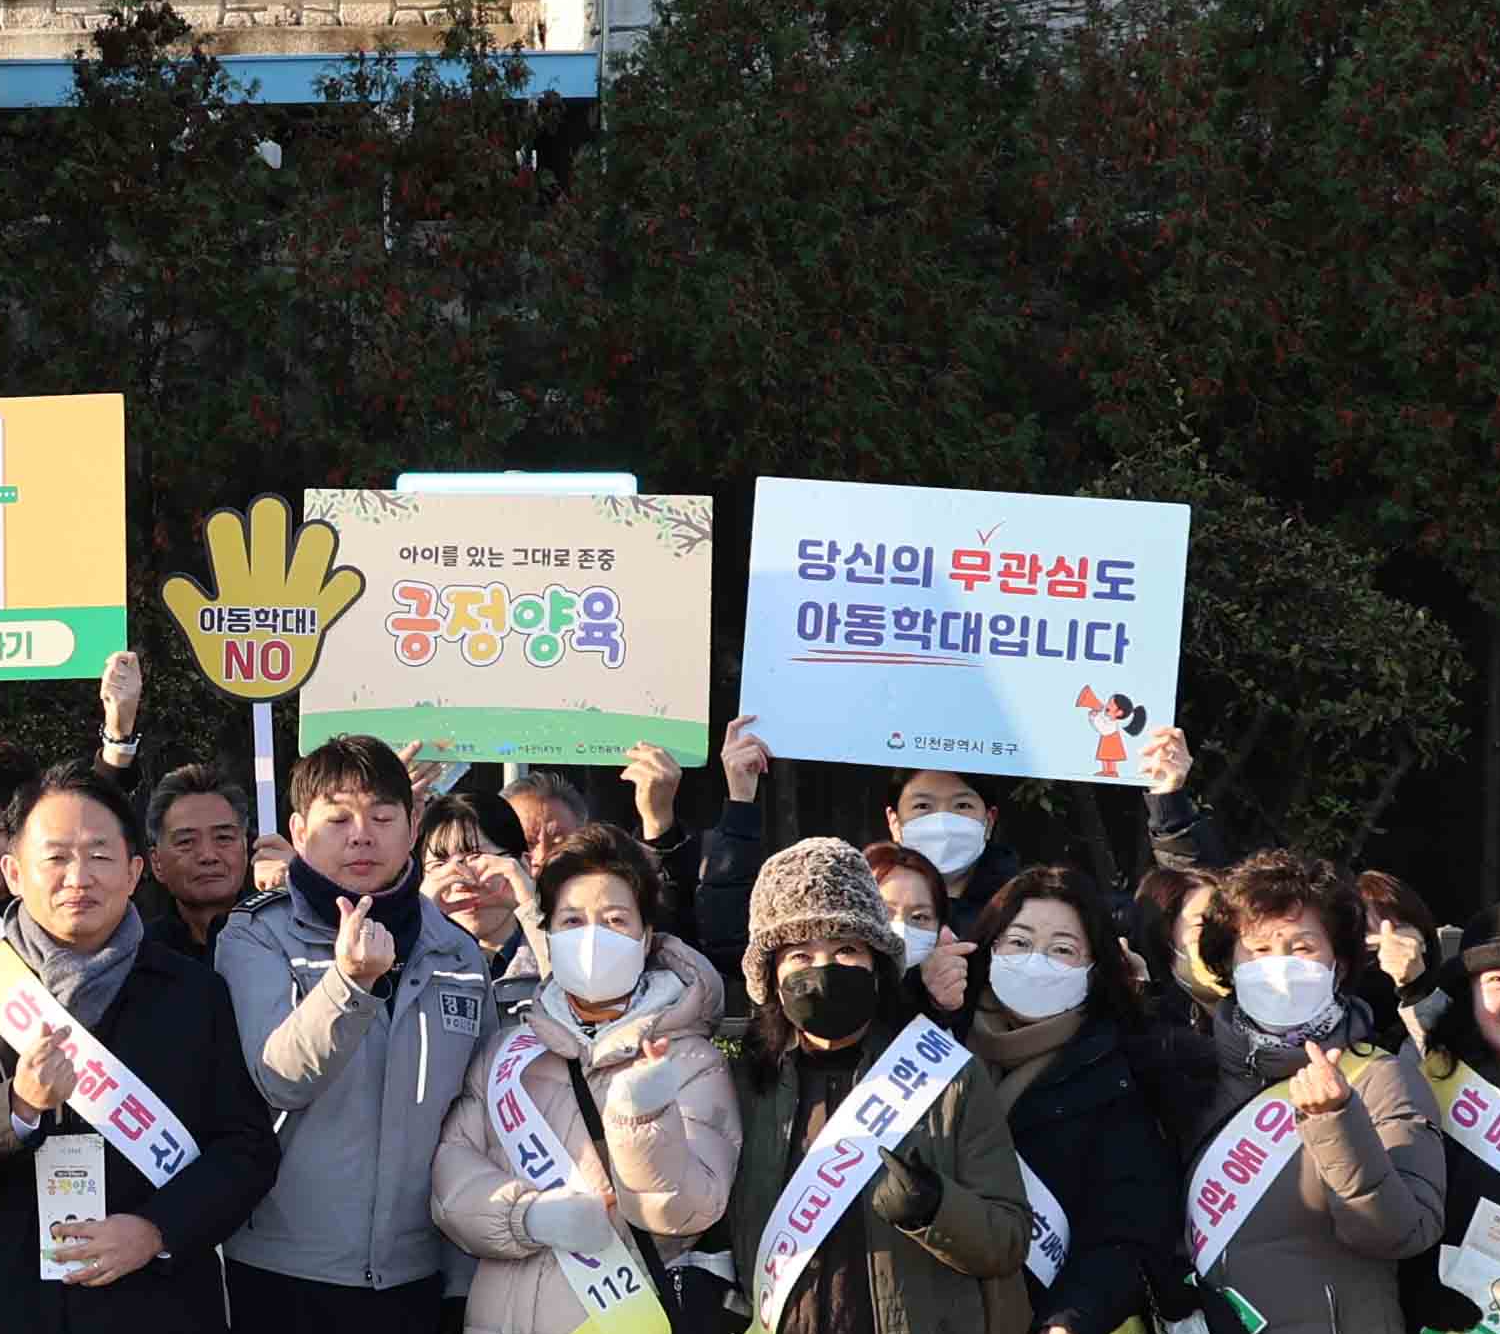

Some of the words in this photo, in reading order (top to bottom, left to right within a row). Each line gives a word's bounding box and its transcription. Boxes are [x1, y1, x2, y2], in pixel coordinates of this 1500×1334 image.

[399, 544, 460, 568] 아이를
[466, 545, 505, 569] 있는
[511, 546, 570, 569] 그대로
[577, 547, 616, 571] 존중
[798, 538, 934, 588] 당신의
[948, 548, 1135, 602] 무관심도
[199, 605, 317, 636] 아동학대!
[388, 582, 624, 668] 긍정양육
[797, 600, 1129, 665] 아동학대입니다
[223, 639, 293, 683] NO
[914, 734, 985, 754] 인천광역시
[990, 739, 1019, 757] 동구
[853, 1027, 954, 1138] 동학대
[585, 1266, 643, 1313] 112
